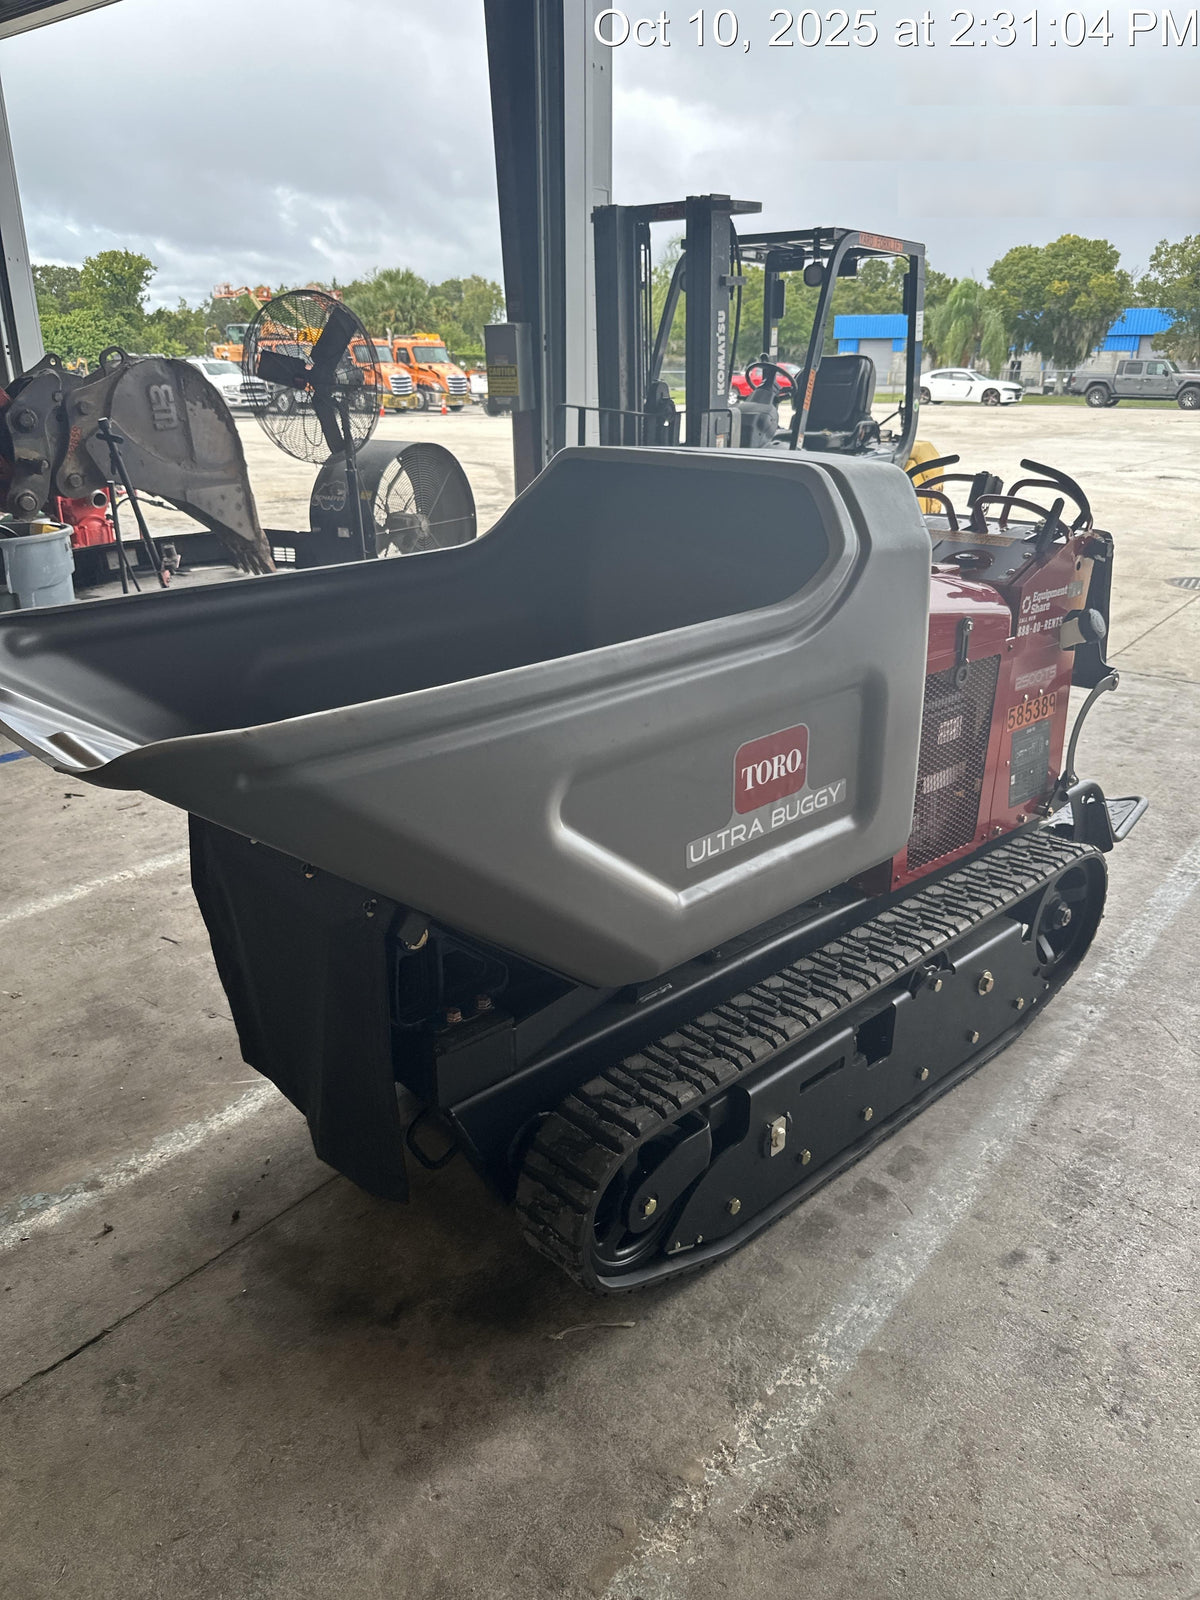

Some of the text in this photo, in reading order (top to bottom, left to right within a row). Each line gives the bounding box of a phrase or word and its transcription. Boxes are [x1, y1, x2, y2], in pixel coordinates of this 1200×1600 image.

[716, 310, 726, 396] KOMATSU
[1030, 602, 1051, 614] Share
[1032, 585, 1068, 603] Equipment
[1008, 693, 1056, 730] 585389
[741, 748, 802, 791] TORO
[690, 782, 841, 862] ULTRA BUGGY
